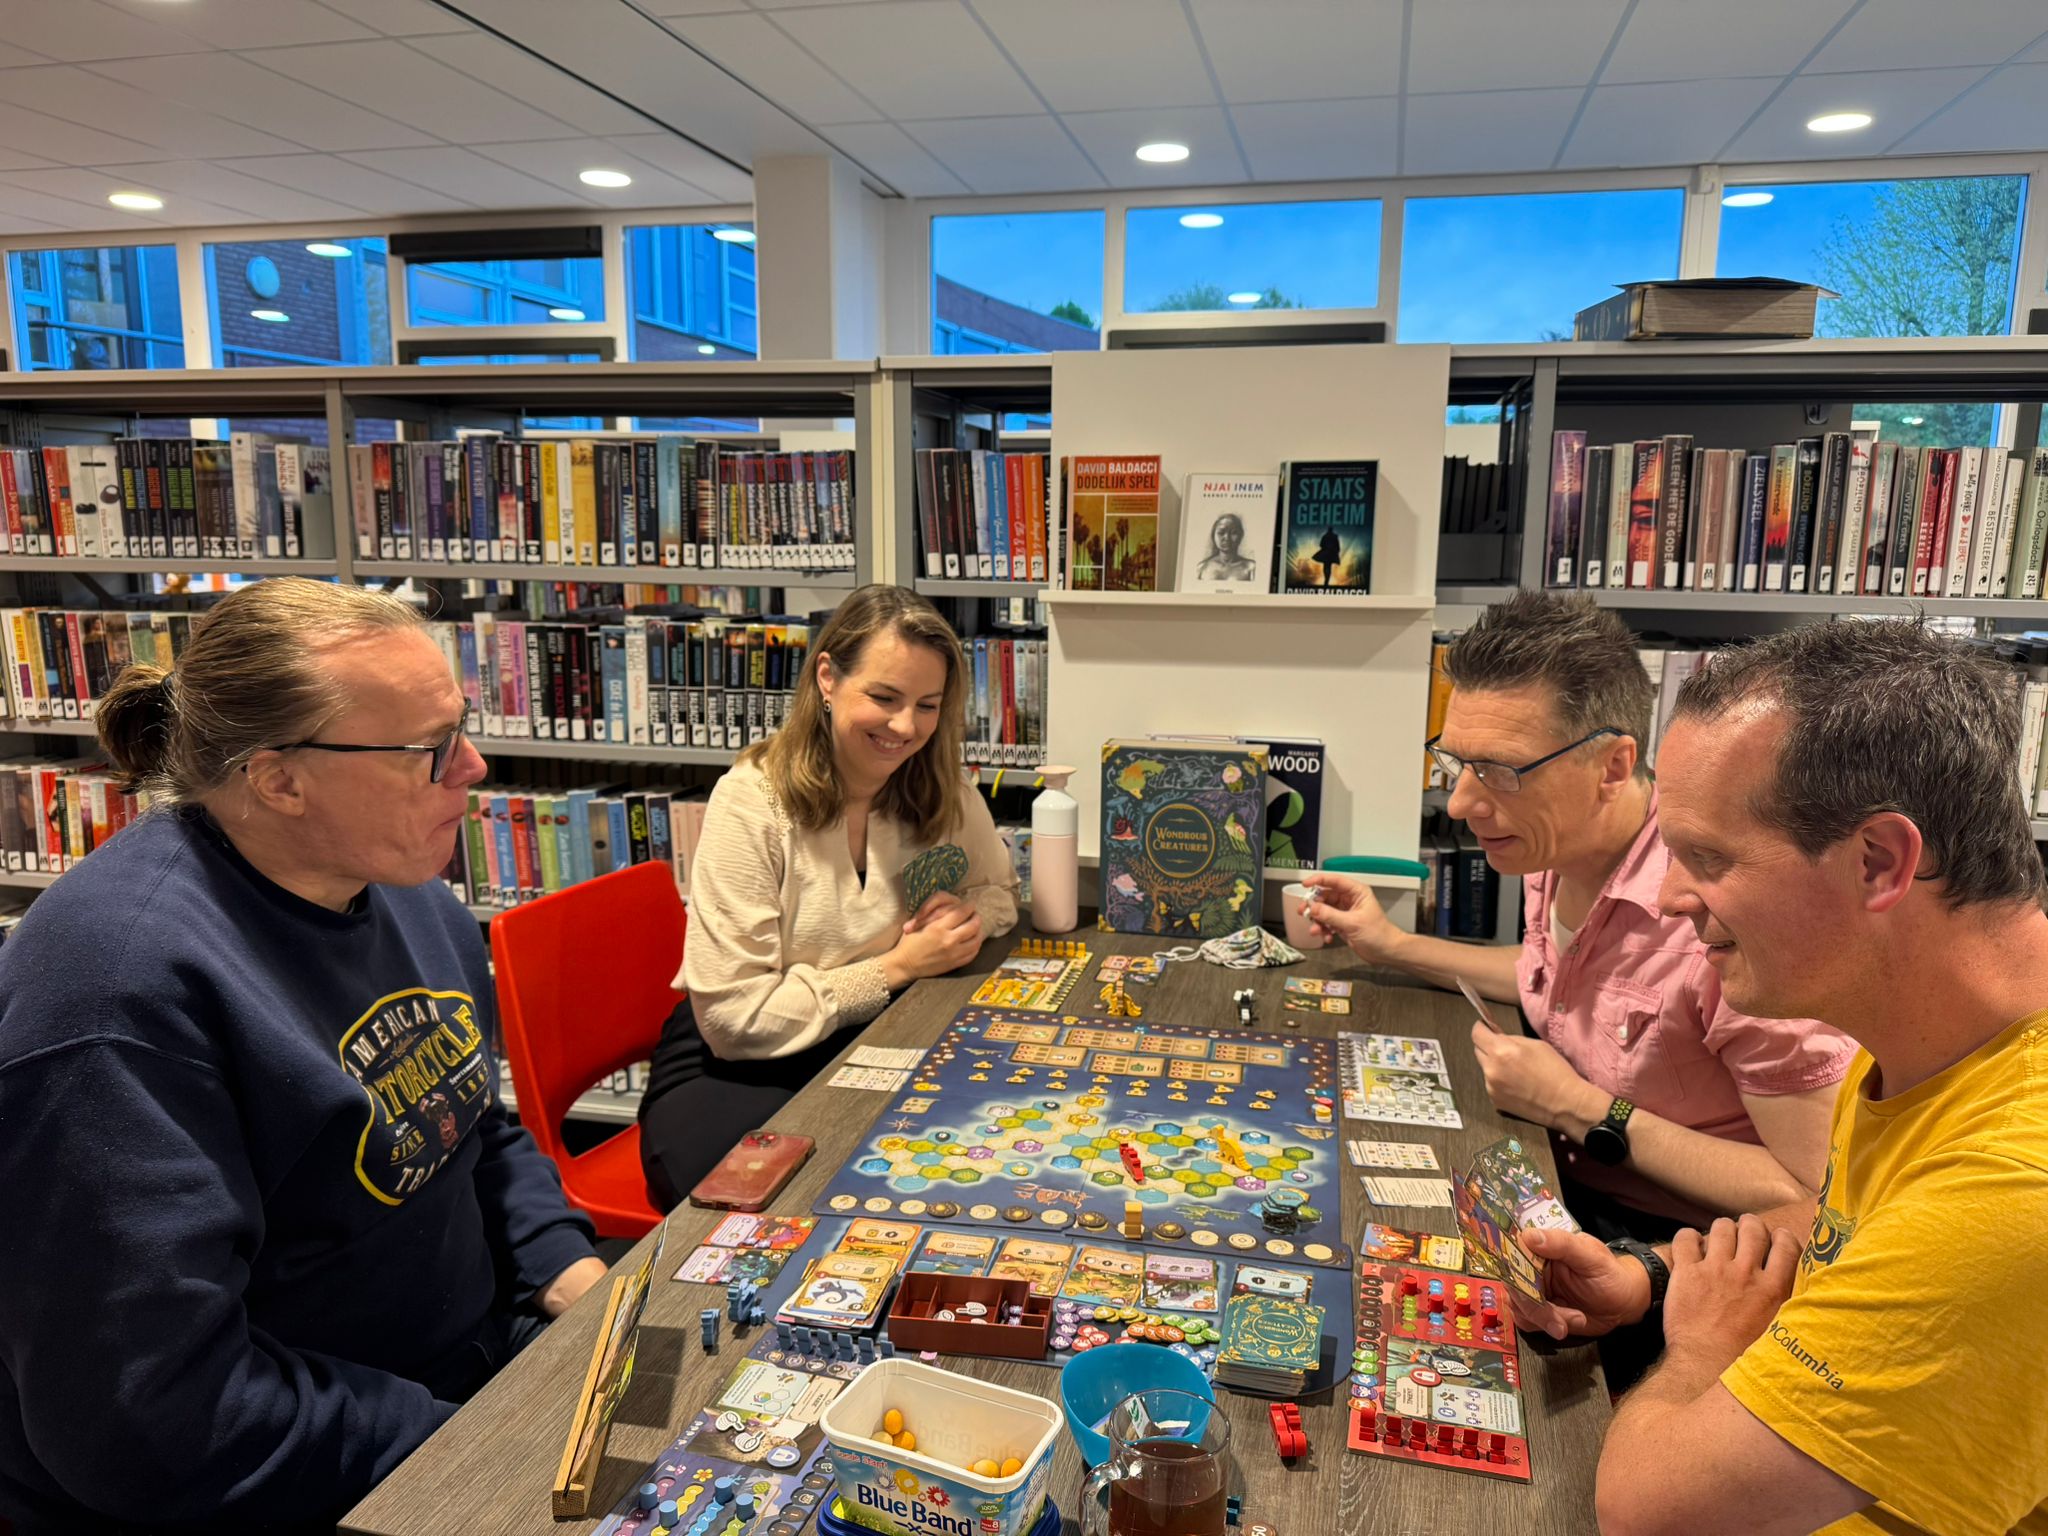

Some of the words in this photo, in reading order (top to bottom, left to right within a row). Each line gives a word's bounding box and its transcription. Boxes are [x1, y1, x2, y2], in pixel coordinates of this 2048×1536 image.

[472, 440, 481, 458] KATE
[287, 456, 296, 485] STEFAN
[1077, 463, 1106, 474] DAVID
[1108, 462, 1158, 473] BALDACCI
[1670, 445, 1682, 486] ALLEEN
[1777, 457, 1786, 467] De
[1995, 455, 2003, 472] MANO
[473, 460, 483, 497] ATKINSON
[1077, 475, 1126, 489] DODELIJK
[1129, 475, 1156, 489] SPEL
[1203, 483, 1231, 492] NJAI
[1234, 483, 1264, 492] INEM
[1299, 477, 1365, 500] STAATS
[1668, 488, 1679, 509] MET
[1752, 467, 1766, 523] ZIELSVEEL
[1772, 469, 1784, 516] zonnewende
[1902, 492, 1910, 513] OVER
[623, 494, 635, 537] FATIMA
[1296, 503, 1366, 525] GEHEIM
[1667, 513, 1677, 527] DE
[1898, 528, 1908, 552] GRENS
[1917, 522, 1928, 559] BEREIK
[528, 632, 537, 647] HET
[528, 649, 539, 674] SPOOR
[531, 675, 540, 689] VAN
[609, 679, 623, 700] CISKE
[531, 691, 541, 700] DE
[649, 691, 659, 724] BALDACC
[670, 691, 678, 724] BALDACC
[689, 692, 698, 724] BALDACC
[726, 695, 735, 727] BALDACC
[748, 694, 756, 727] BALDACC
[765, 695, 773, 727] BALDACC
[1268, 755, 1320, 774] WOOD
[1152, 839, 1209, 852] CREATURES
[1155, 827, 1208, 841] WONDROUS
[346, 999, 441, 1083] AMERICAN
[370, 1004, 482, 1124] TORCYCLE
[1773, 1326, 1845, 1390] Columbia
[857, 1483, 908, 1518] Blue
[912, 1501, 972, 1536] Band
